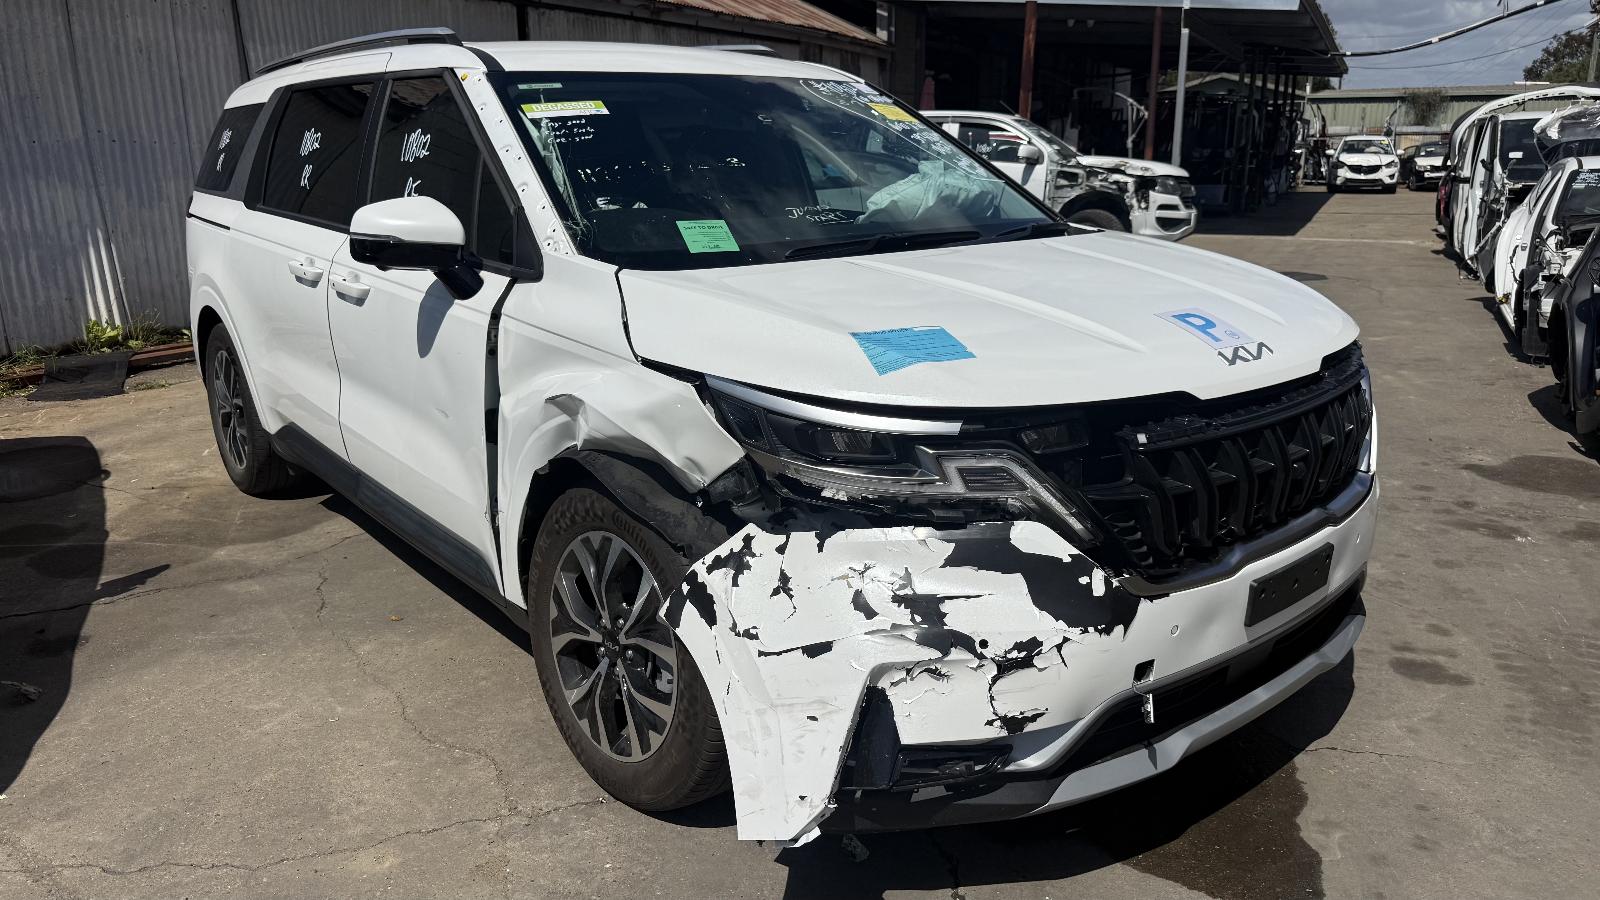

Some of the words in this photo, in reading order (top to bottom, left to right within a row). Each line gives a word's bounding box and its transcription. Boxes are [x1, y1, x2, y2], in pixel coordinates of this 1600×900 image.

[531, 102, 596, 112] DEGASSED
[300, 128, 321, 156] 10802
[401, 128, 431, 162] 10802
[1171, 312, 1224, 343] P
[1217, 341, 1274, 366] KIA
